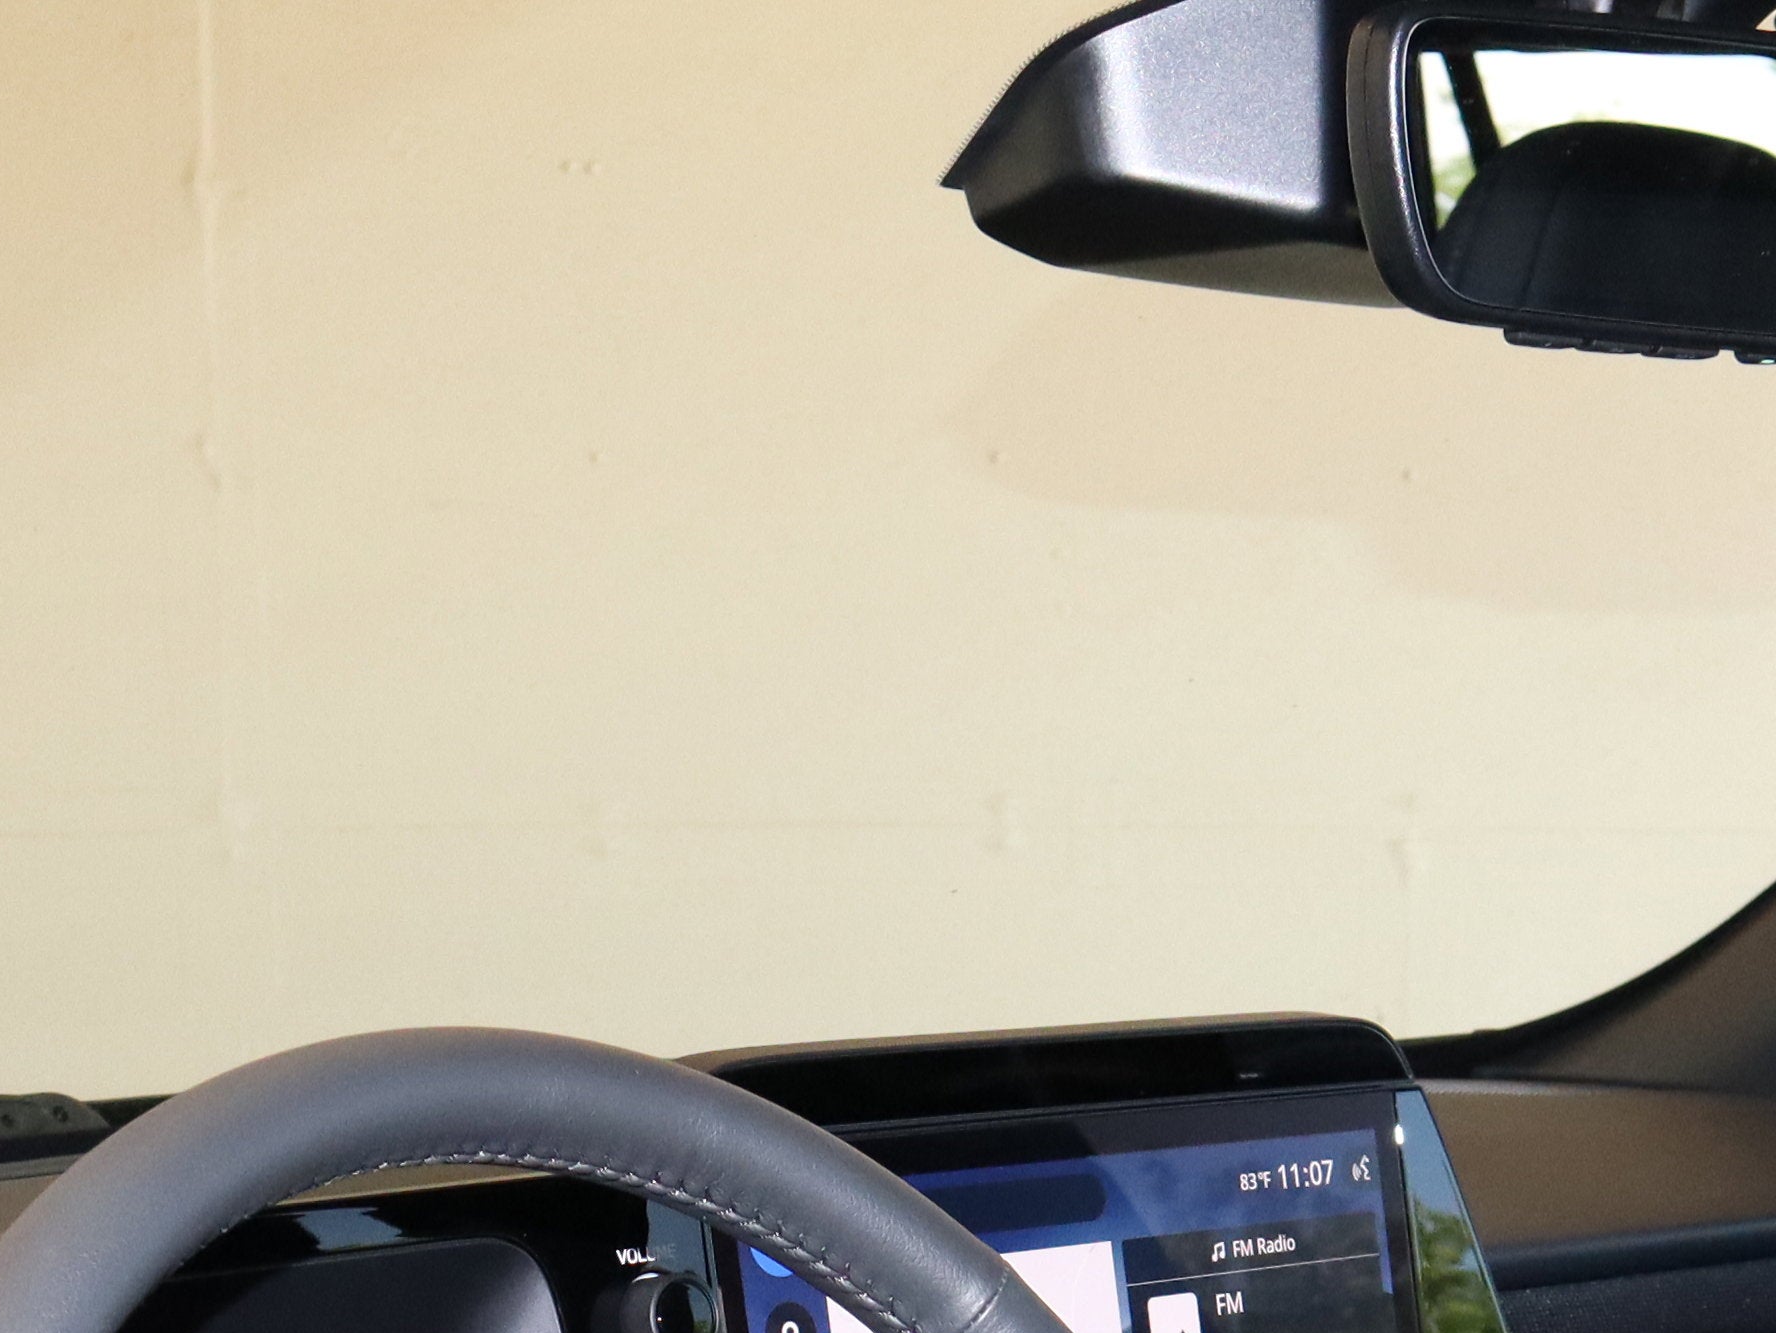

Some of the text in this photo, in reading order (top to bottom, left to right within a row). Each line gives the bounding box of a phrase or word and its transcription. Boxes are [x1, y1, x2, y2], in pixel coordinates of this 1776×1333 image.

[1239, 1159, 1334, 1192] 83°F 11:07
[1232, 1234, 1296, 1258] FM Radio
[1215, 1291, 1245, 1316] FM
